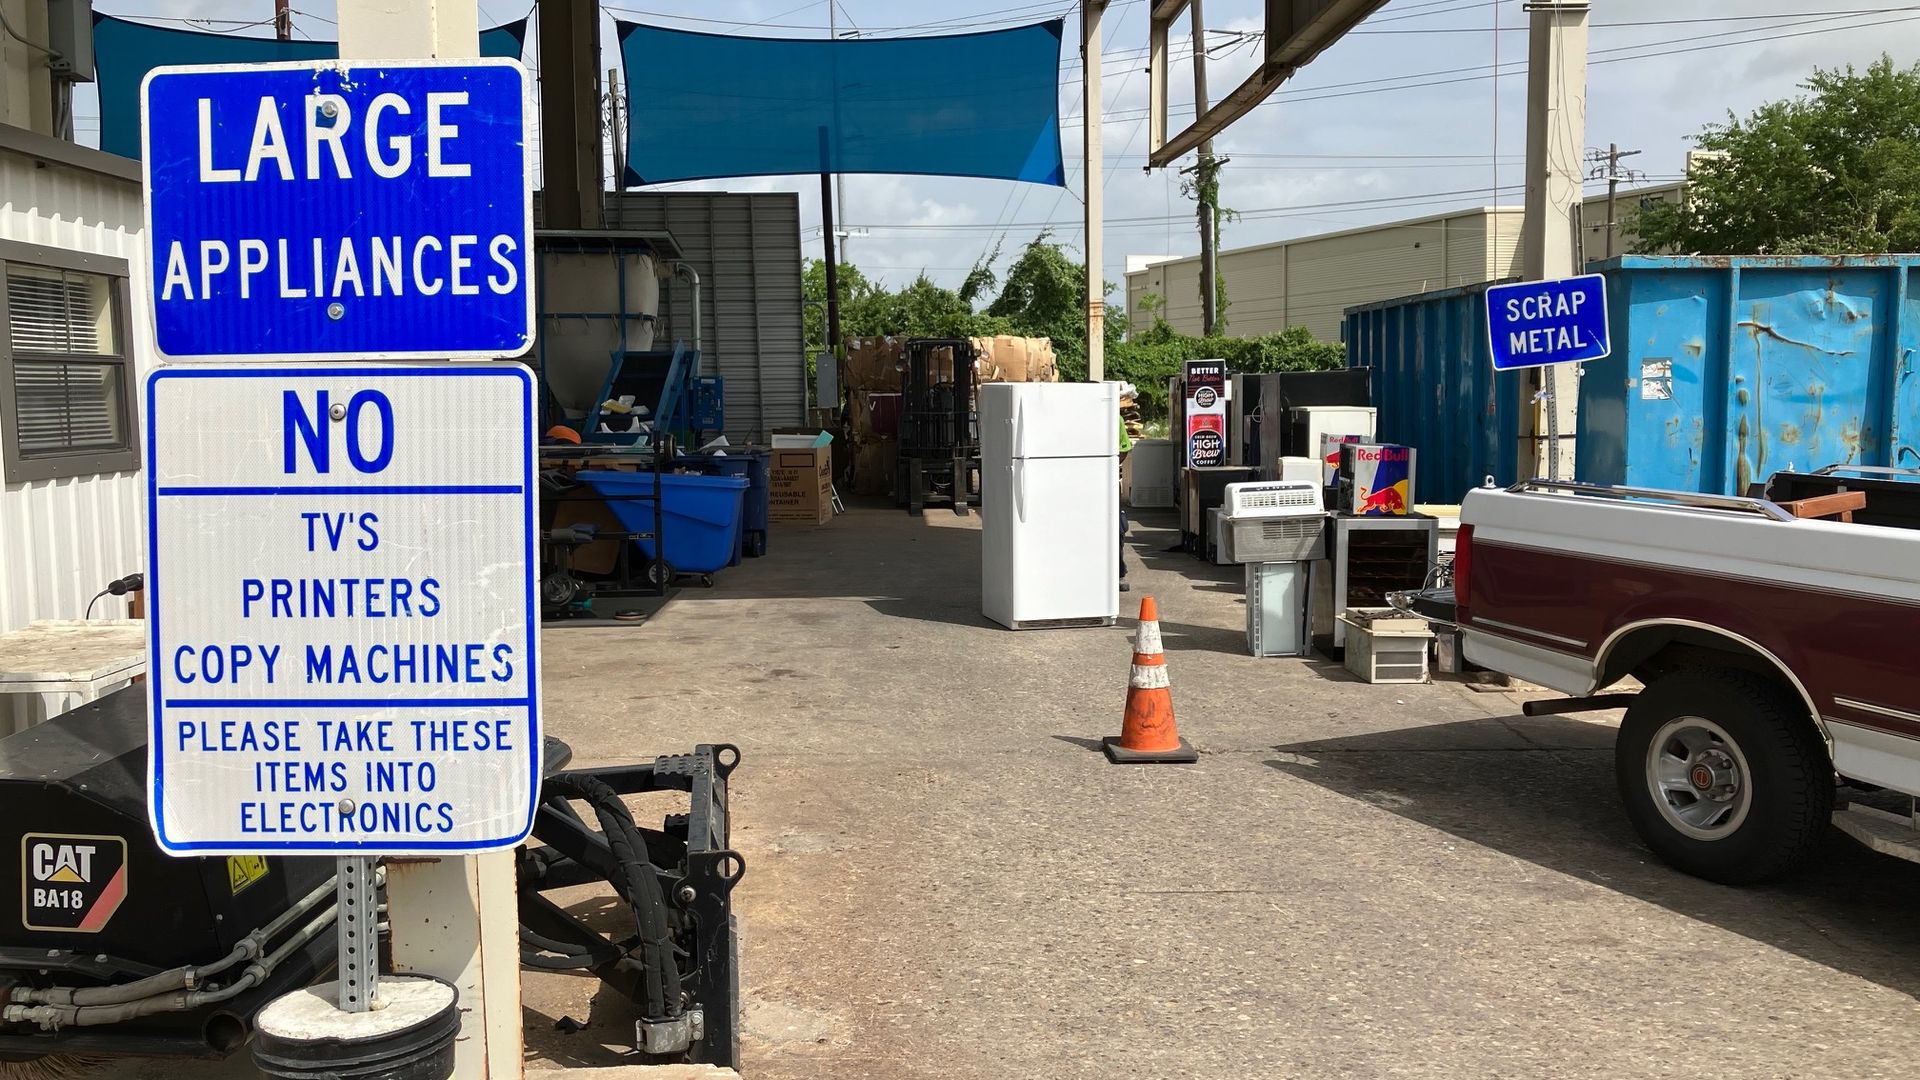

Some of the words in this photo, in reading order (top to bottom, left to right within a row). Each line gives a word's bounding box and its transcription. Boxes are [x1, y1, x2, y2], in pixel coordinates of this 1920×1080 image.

[199, 92, 471, 182] LARGE
[161, 234, 518, 300] APPLIANCES
[1507, 291, 1586, 322] SCRAP
[1510, 325, 1587, 355] METAL
[283, 388, 395, 474] NO
[1192, 439, 1220, 449] HIGH
[1192, 448, 1220, 459] Brew
[1357, 448, 1381, 461] Red
[1384, 448, 1409, 461] Bull
[301, 512, 379, 551] TV'S
[243, 578, 441, 618] PRINTERS
[174, 645, 281, 684] COPY
[306, 644, 514, 684] MACHINES
[179, 721, 301, 752] PLEASE
[317, 721, 394, 752] TAKE
[411, 720, 513, 751] THESE
[256, 762, 348, 792] ITEMS
[366, 762, 436, 792] INTO
[241, 802, 454, 833] ELECTRONICS
[33, 843, 96, 883] CAT
[34, 888, 83, 909] BA18
